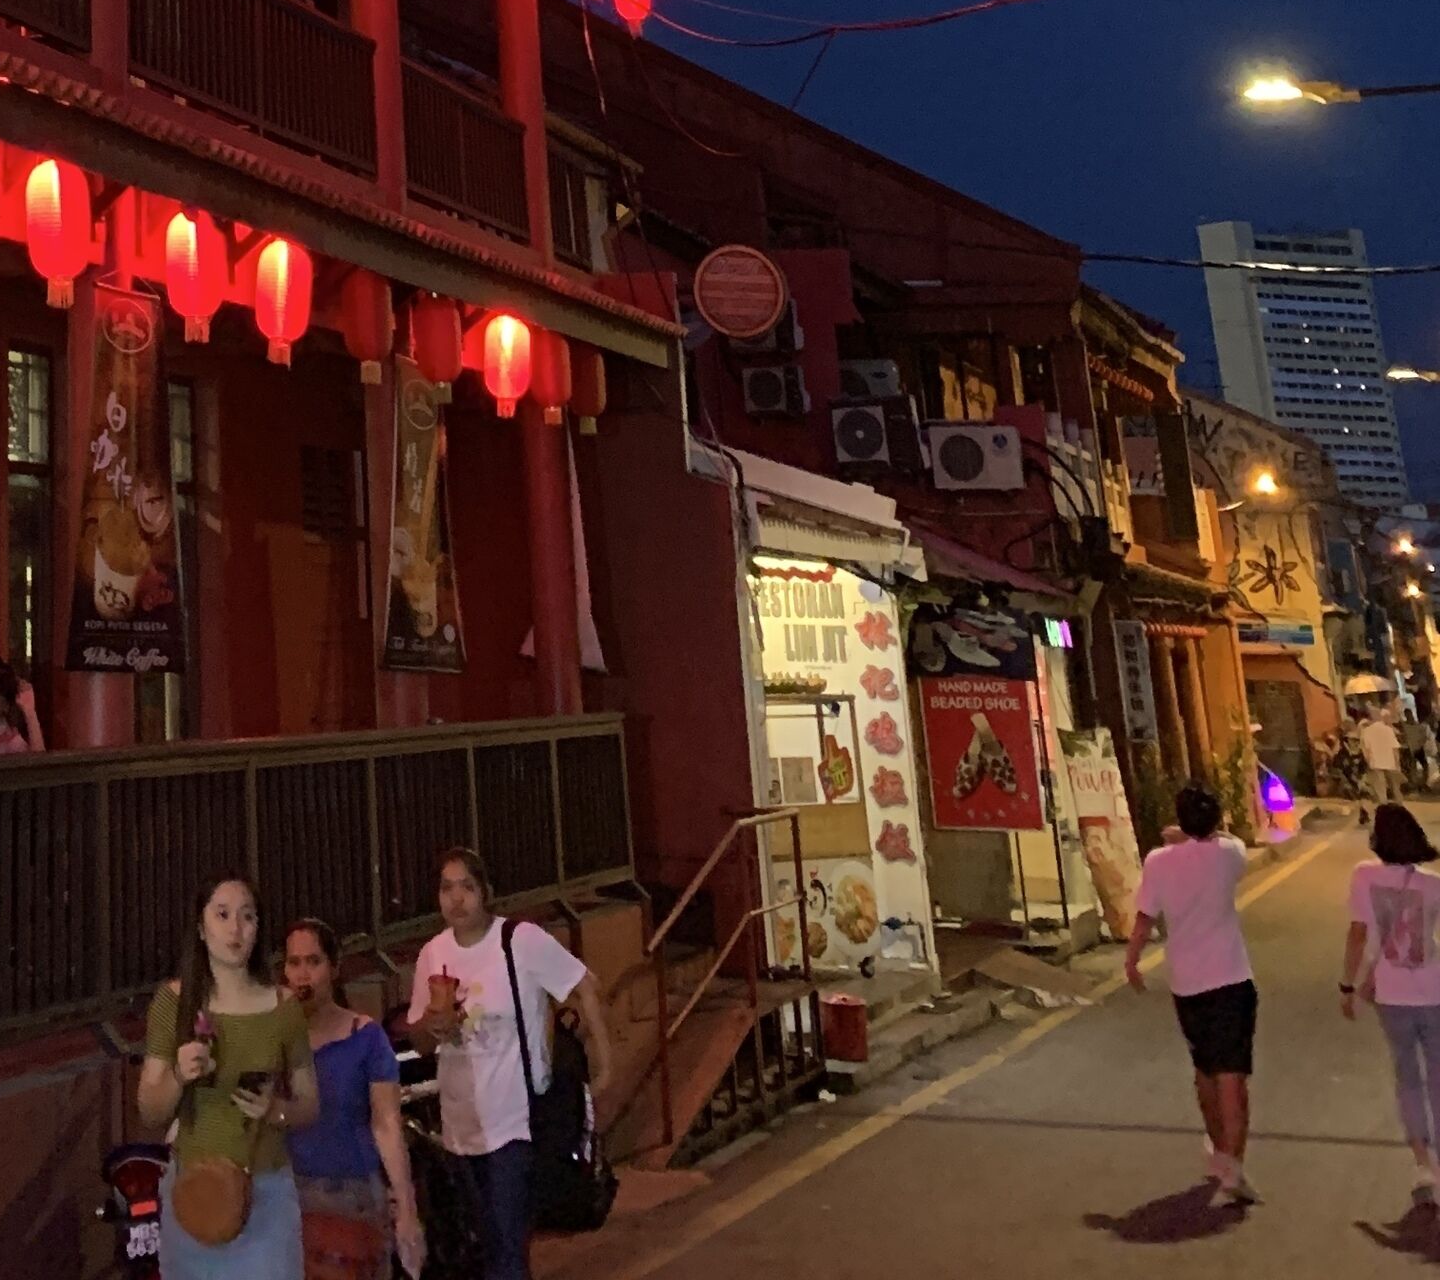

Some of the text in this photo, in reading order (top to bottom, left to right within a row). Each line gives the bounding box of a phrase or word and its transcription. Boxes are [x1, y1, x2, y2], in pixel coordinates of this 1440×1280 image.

[756, 582, 846, 619] ESTORAN
[784, 624, 848, 664] LIM JIT
[937, 681, 1009, 694] HAND MADE
[930, 696, 1021, 711] BEADED SHOE
